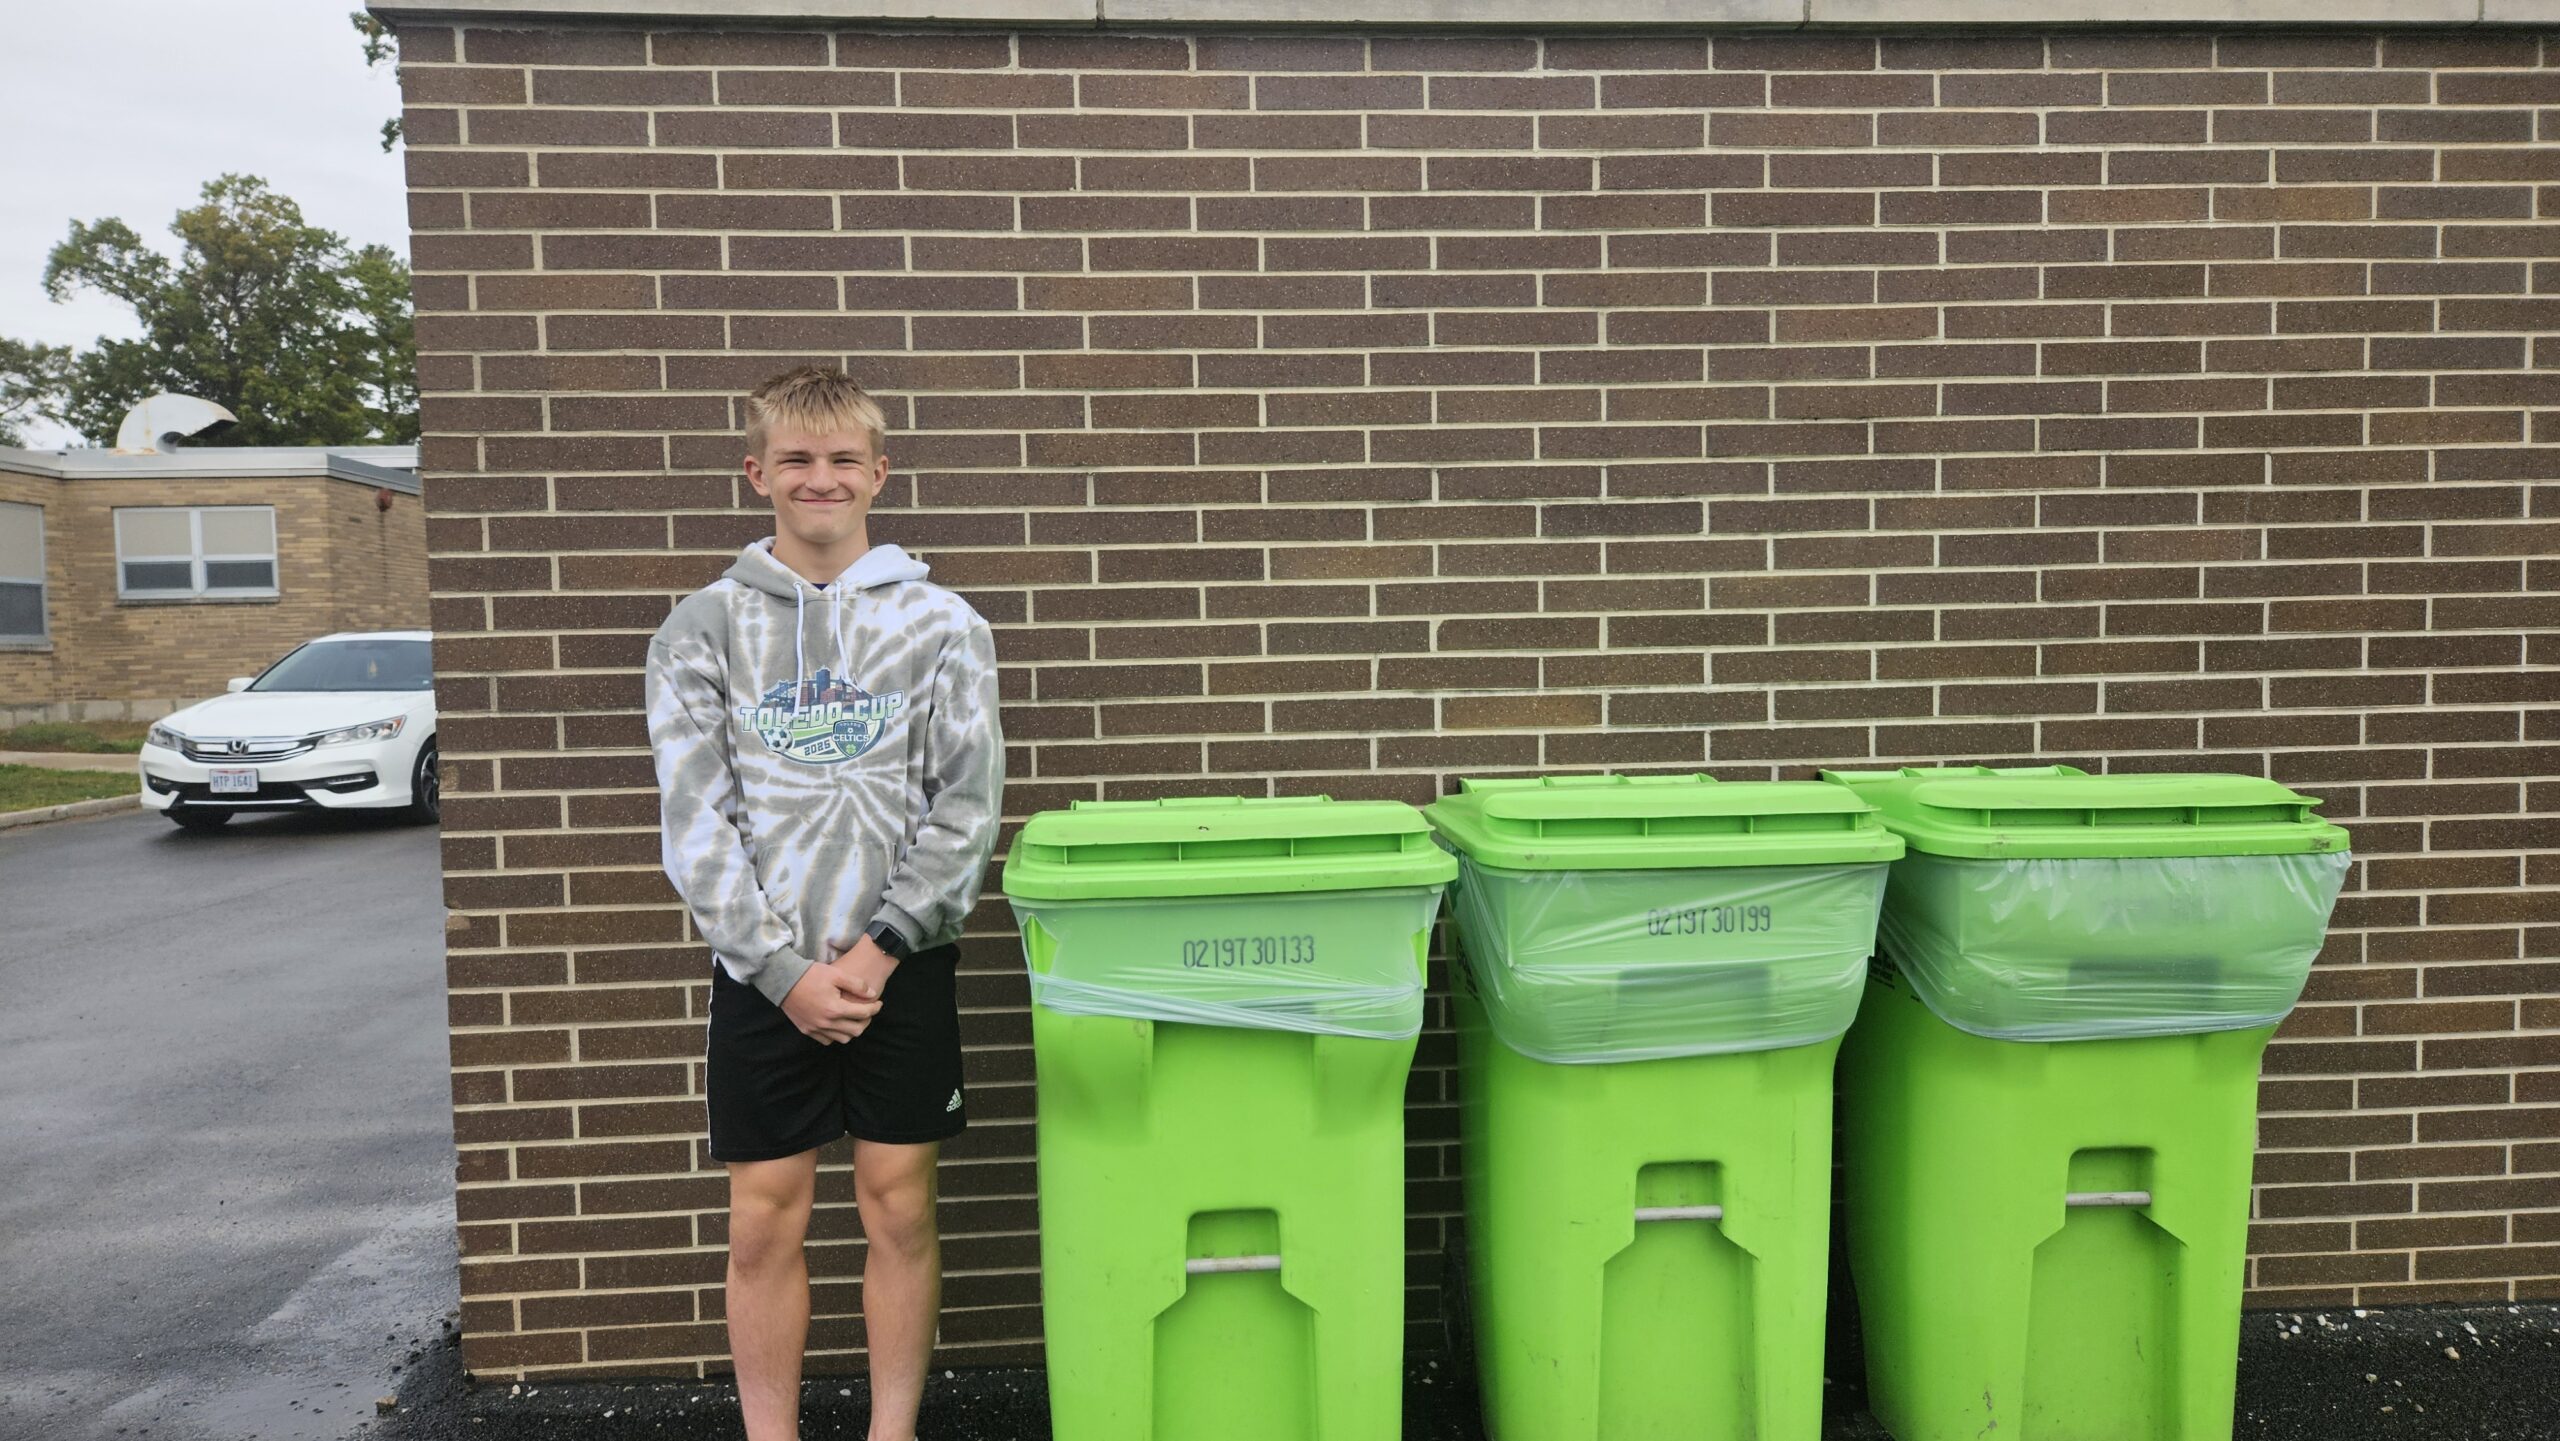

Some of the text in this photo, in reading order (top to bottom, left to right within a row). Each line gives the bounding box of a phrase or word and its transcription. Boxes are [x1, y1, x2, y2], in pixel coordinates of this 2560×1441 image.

[740, 691, 904, 730] TOLEDO CUP
[804, 740, 831, 756] 2025
[832, 733, 870, 742] CELTICS
[1183, 935, 1315, 968] 0219730133
